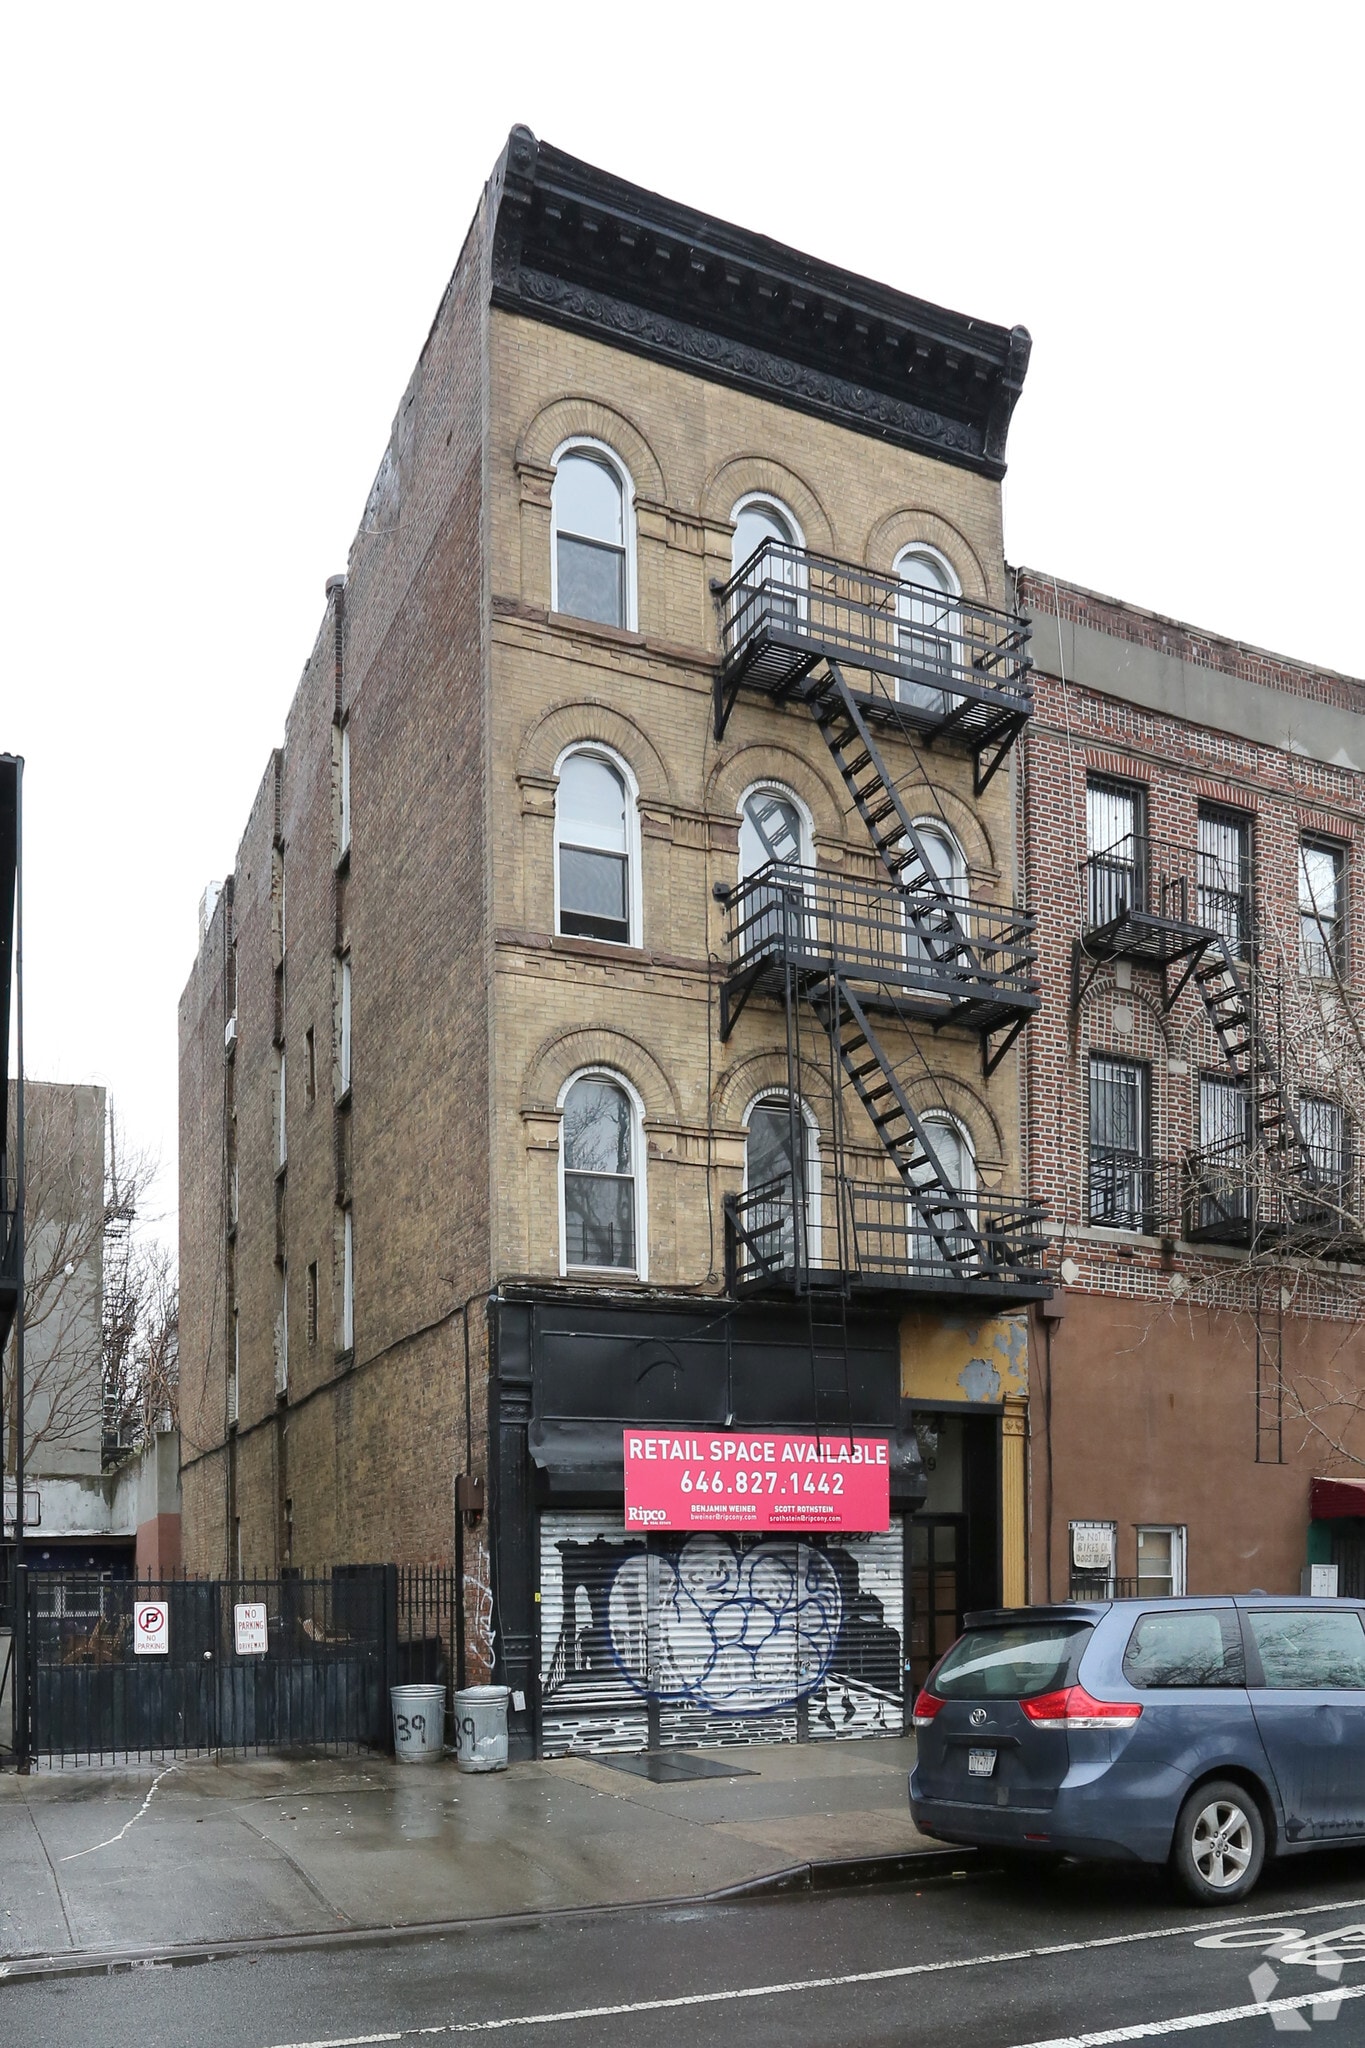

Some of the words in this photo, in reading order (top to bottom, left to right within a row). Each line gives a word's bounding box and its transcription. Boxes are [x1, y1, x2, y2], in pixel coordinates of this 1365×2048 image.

[629, 1438, 704, 1461] RETAIL
[710, 1440, 775, 1463] SPACE
[781, 1442, 887, 1465] AVAILABLE
[680, 1470, 844, 1495] 646.827.1442
[691, 1504, 727, 1513] BENJAMIN
[729, 1505, 756, 1513] WEINER
[774, 1505, 795, 1513] SCOTT
[797, 1505, 834, 1513] ROTHSTEIN
[628, 1506, 666, 1525] Ripco
[690, 1513, 757, 1522] bweiner@ripcony.com
[769, 1514, 842, 1523] srothstein@ripcony.com
[1087, 1532, 1101, 1541] NOT
[1078, 1543, 1099, 1552] BIKES
[244, 1609, 256, 1618] NO
[238, 1620, 263, 1630] PARKING
